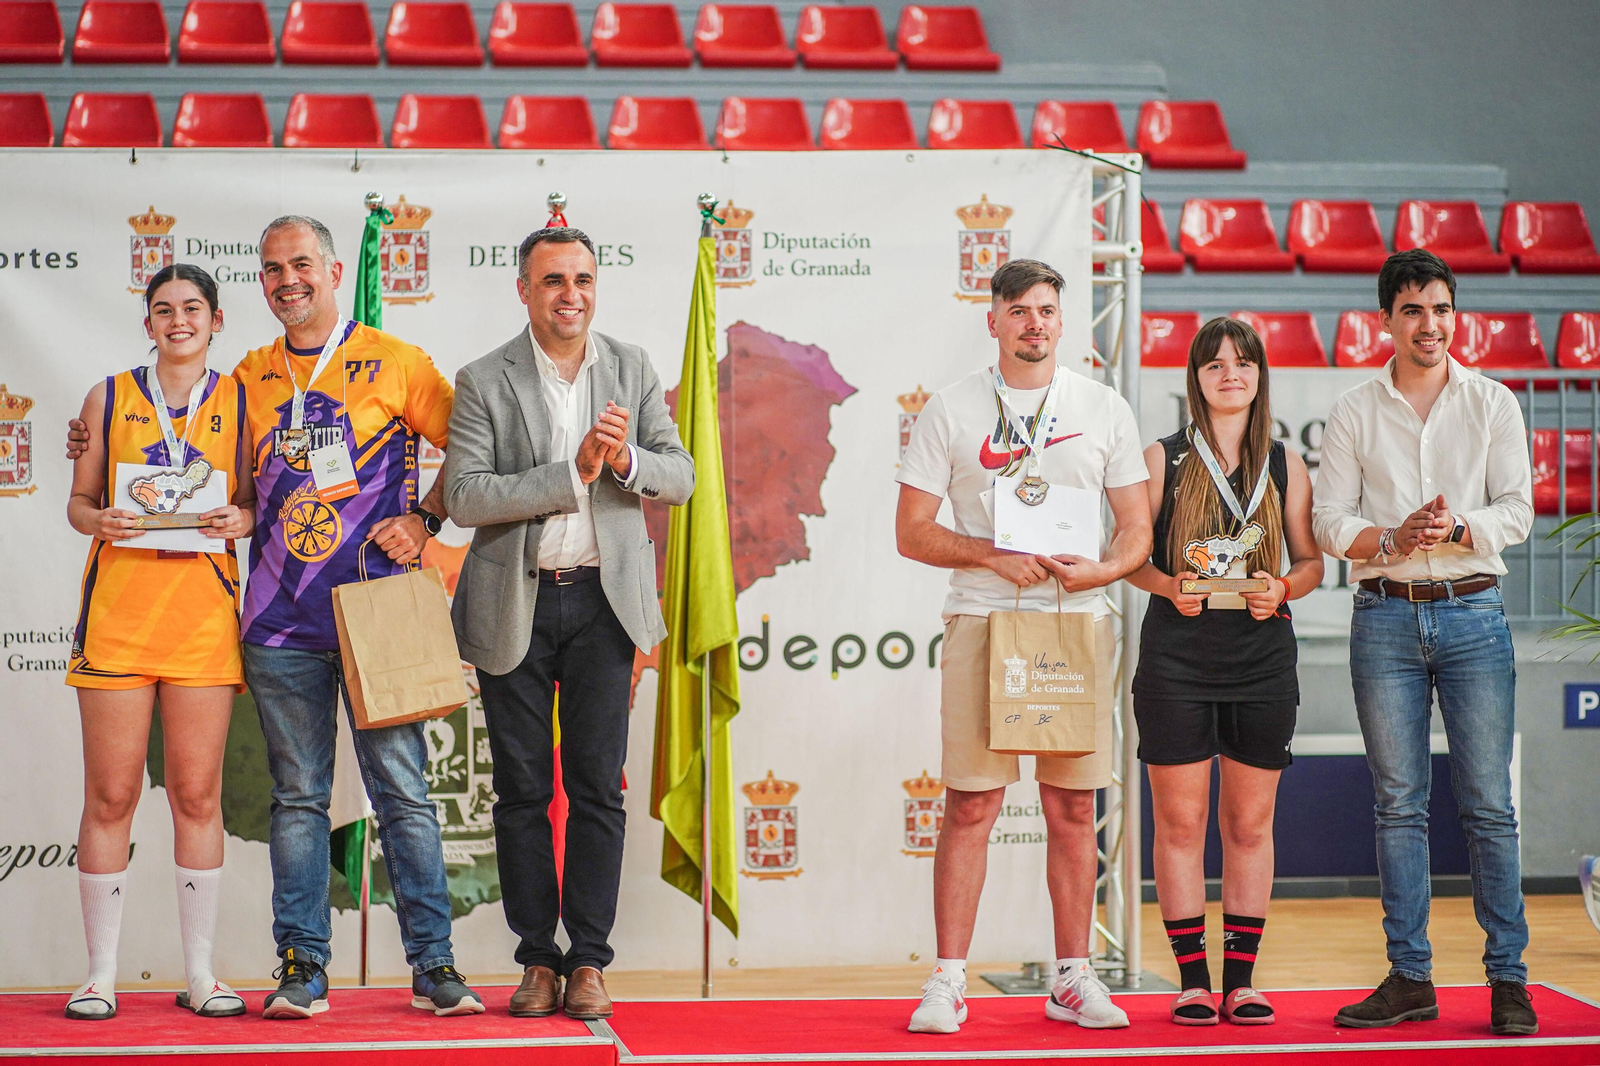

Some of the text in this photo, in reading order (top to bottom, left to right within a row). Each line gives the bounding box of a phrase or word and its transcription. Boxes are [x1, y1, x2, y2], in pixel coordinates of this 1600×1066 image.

[763, 231, 871, 253] Diputación
[763, 258, 871, 276] de Granada
[124, 413, 150, 424] vive
[211, 415, 222, 433] 3
[1031, 671, 1084, 682] Diputación
[1031, 683, 1085, 693] de Granada
